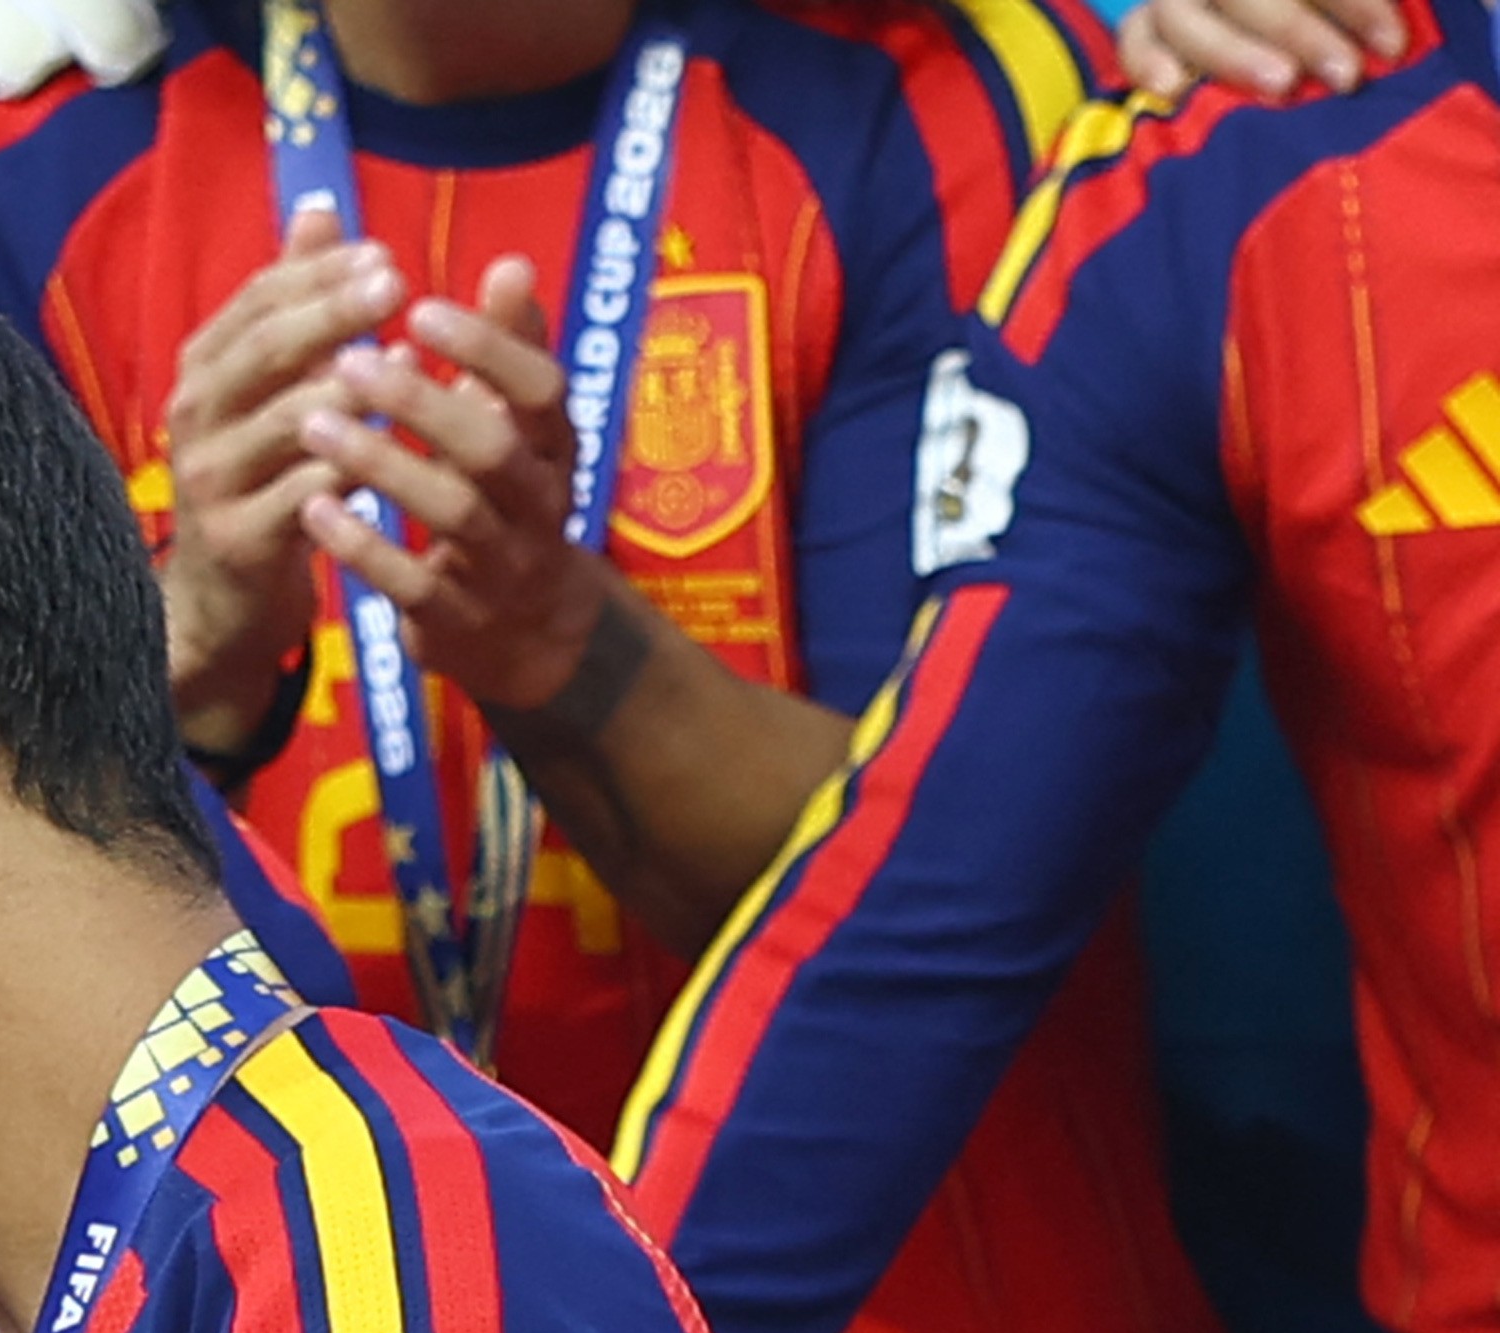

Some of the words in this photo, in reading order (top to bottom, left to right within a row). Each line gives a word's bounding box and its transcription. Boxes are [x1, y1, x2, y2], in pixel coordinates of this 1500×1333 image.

[605, 40, 684, 219] 2026
[583, 217, 641, 327] CUP
[563, 325, 621, 544] ORLD
[353, 592, 417, 777] 2026
[52, 1222, 118, 1333] FIFA
